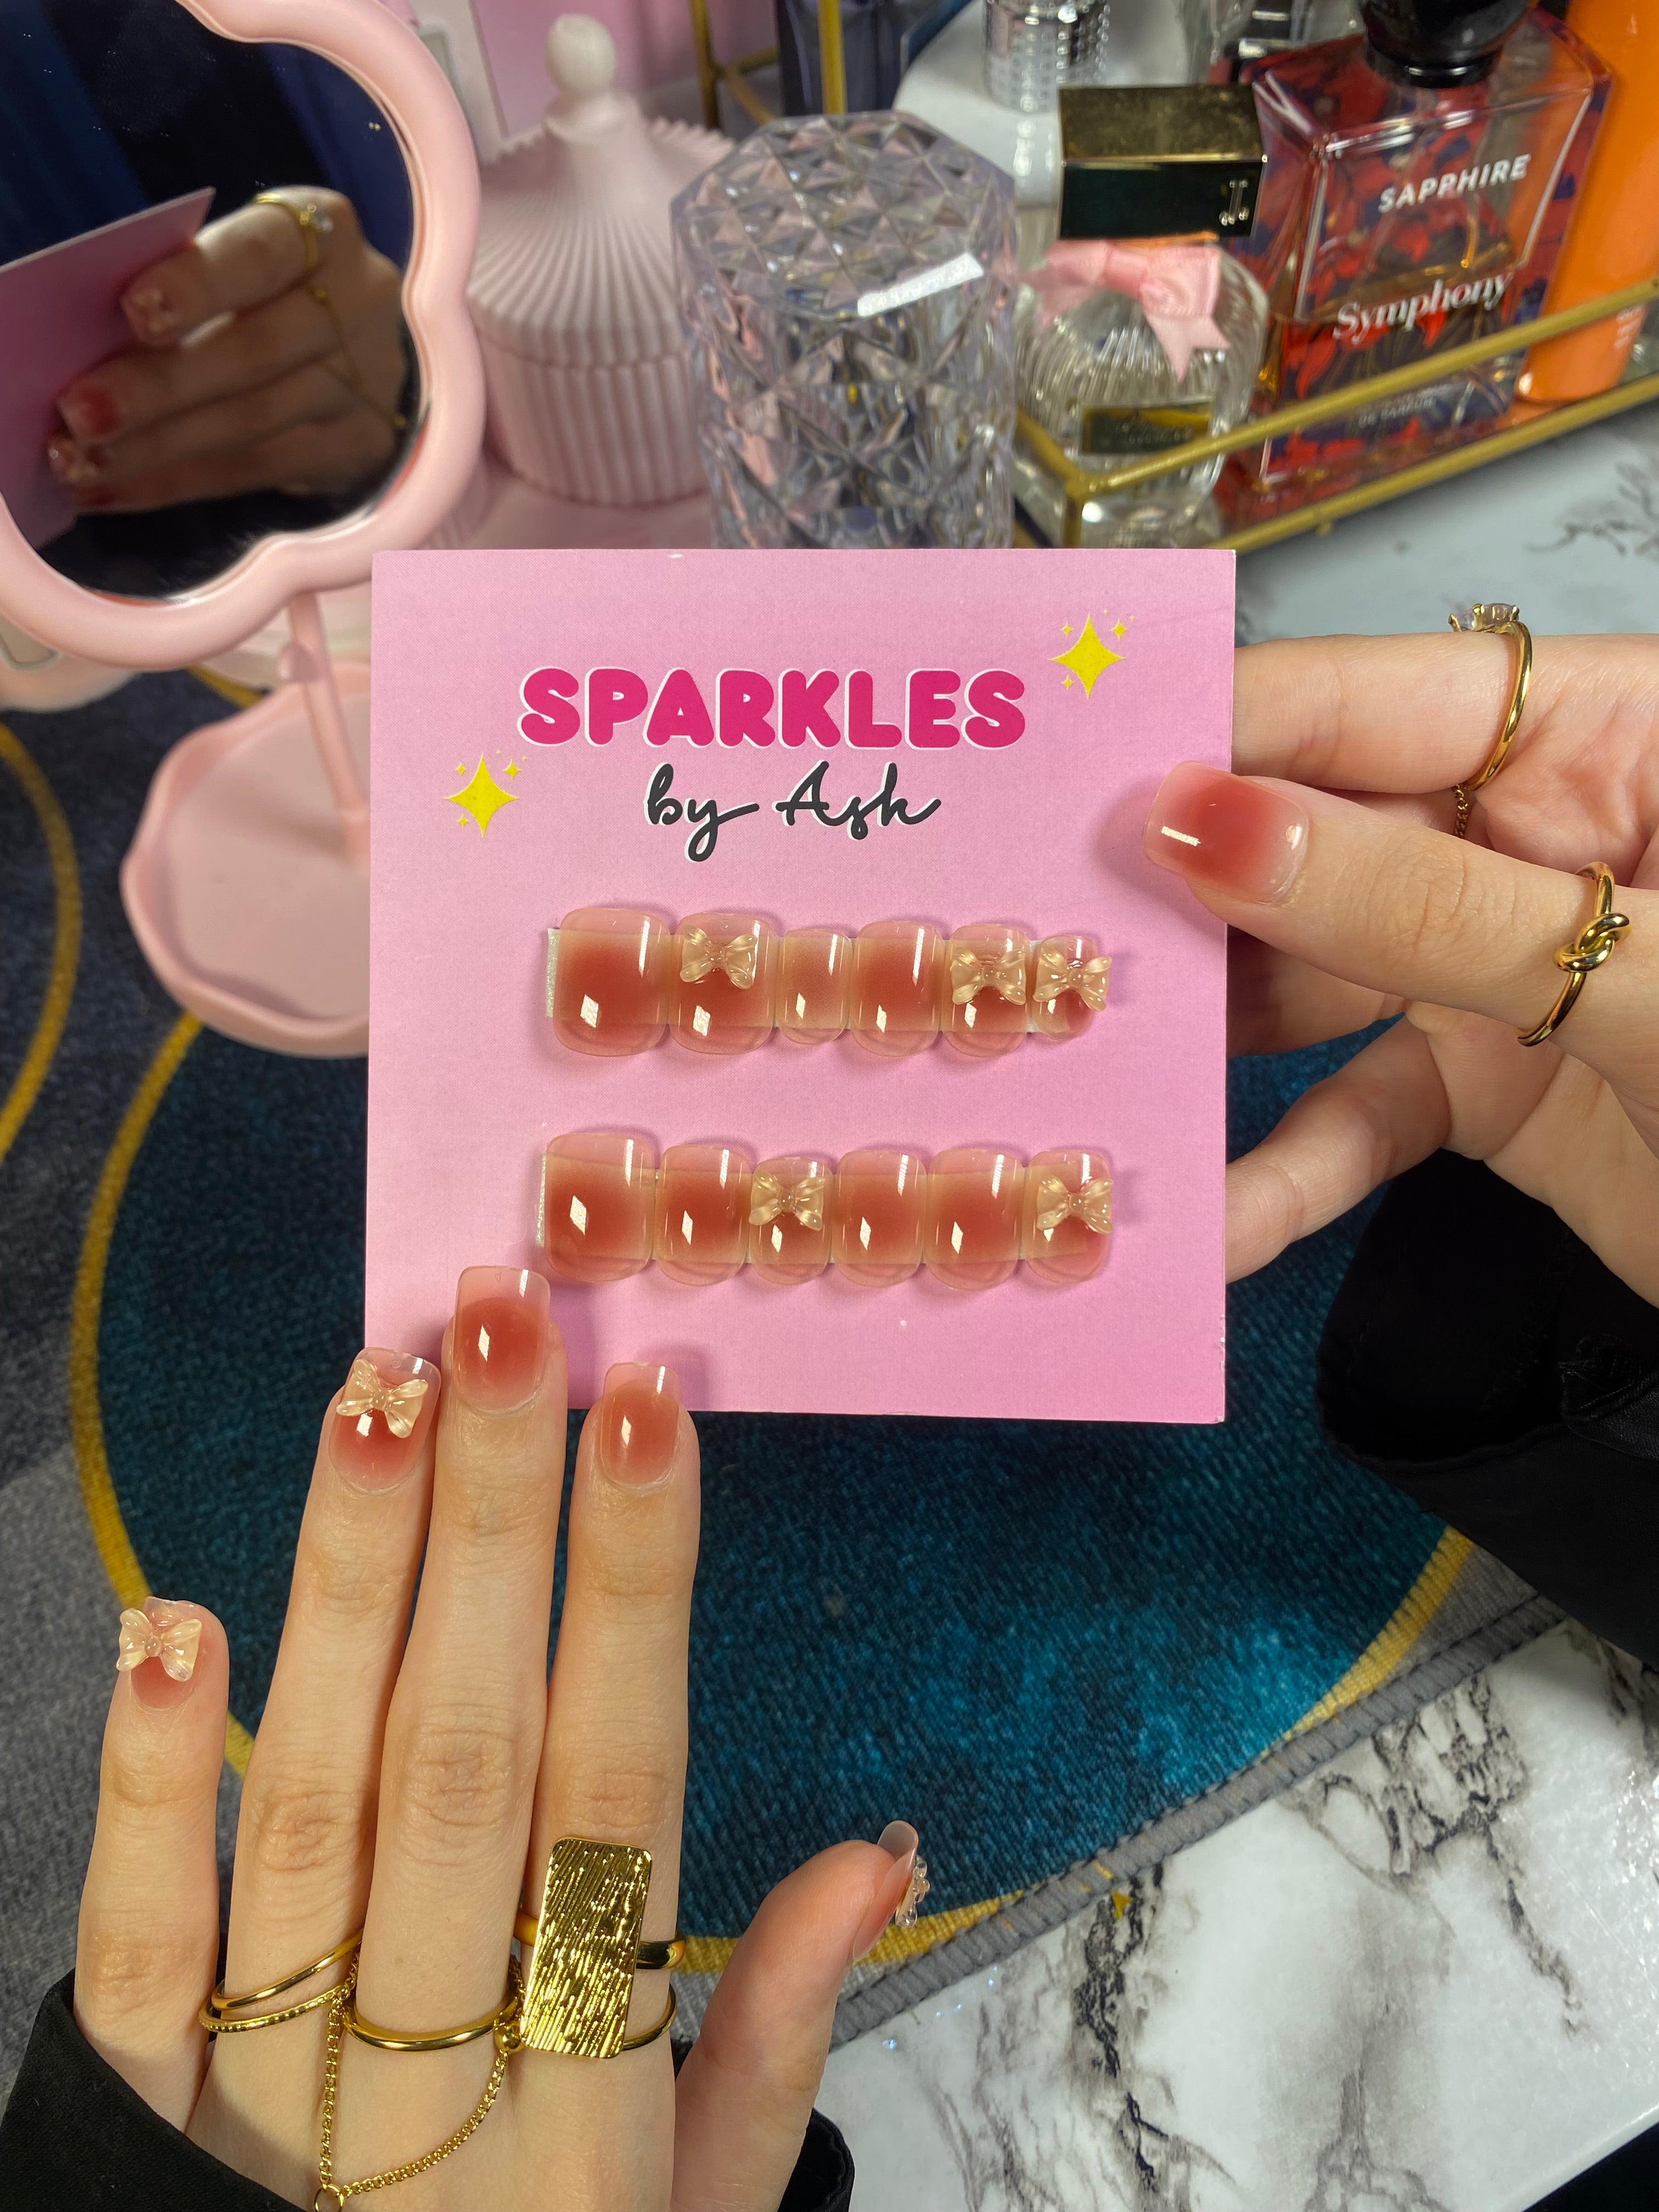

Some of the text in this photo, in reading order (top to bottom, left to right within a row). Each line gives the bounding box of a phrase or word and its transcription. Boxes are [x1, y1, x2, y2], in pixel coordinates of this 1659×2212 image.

[1378, 153, 1531, 213] SAPPHIRE
[1332, 272, 1515, 345] Symphony
[518, 667, 1026, 749] SPARKLES
[645, 760, 941, 862] by Ash
